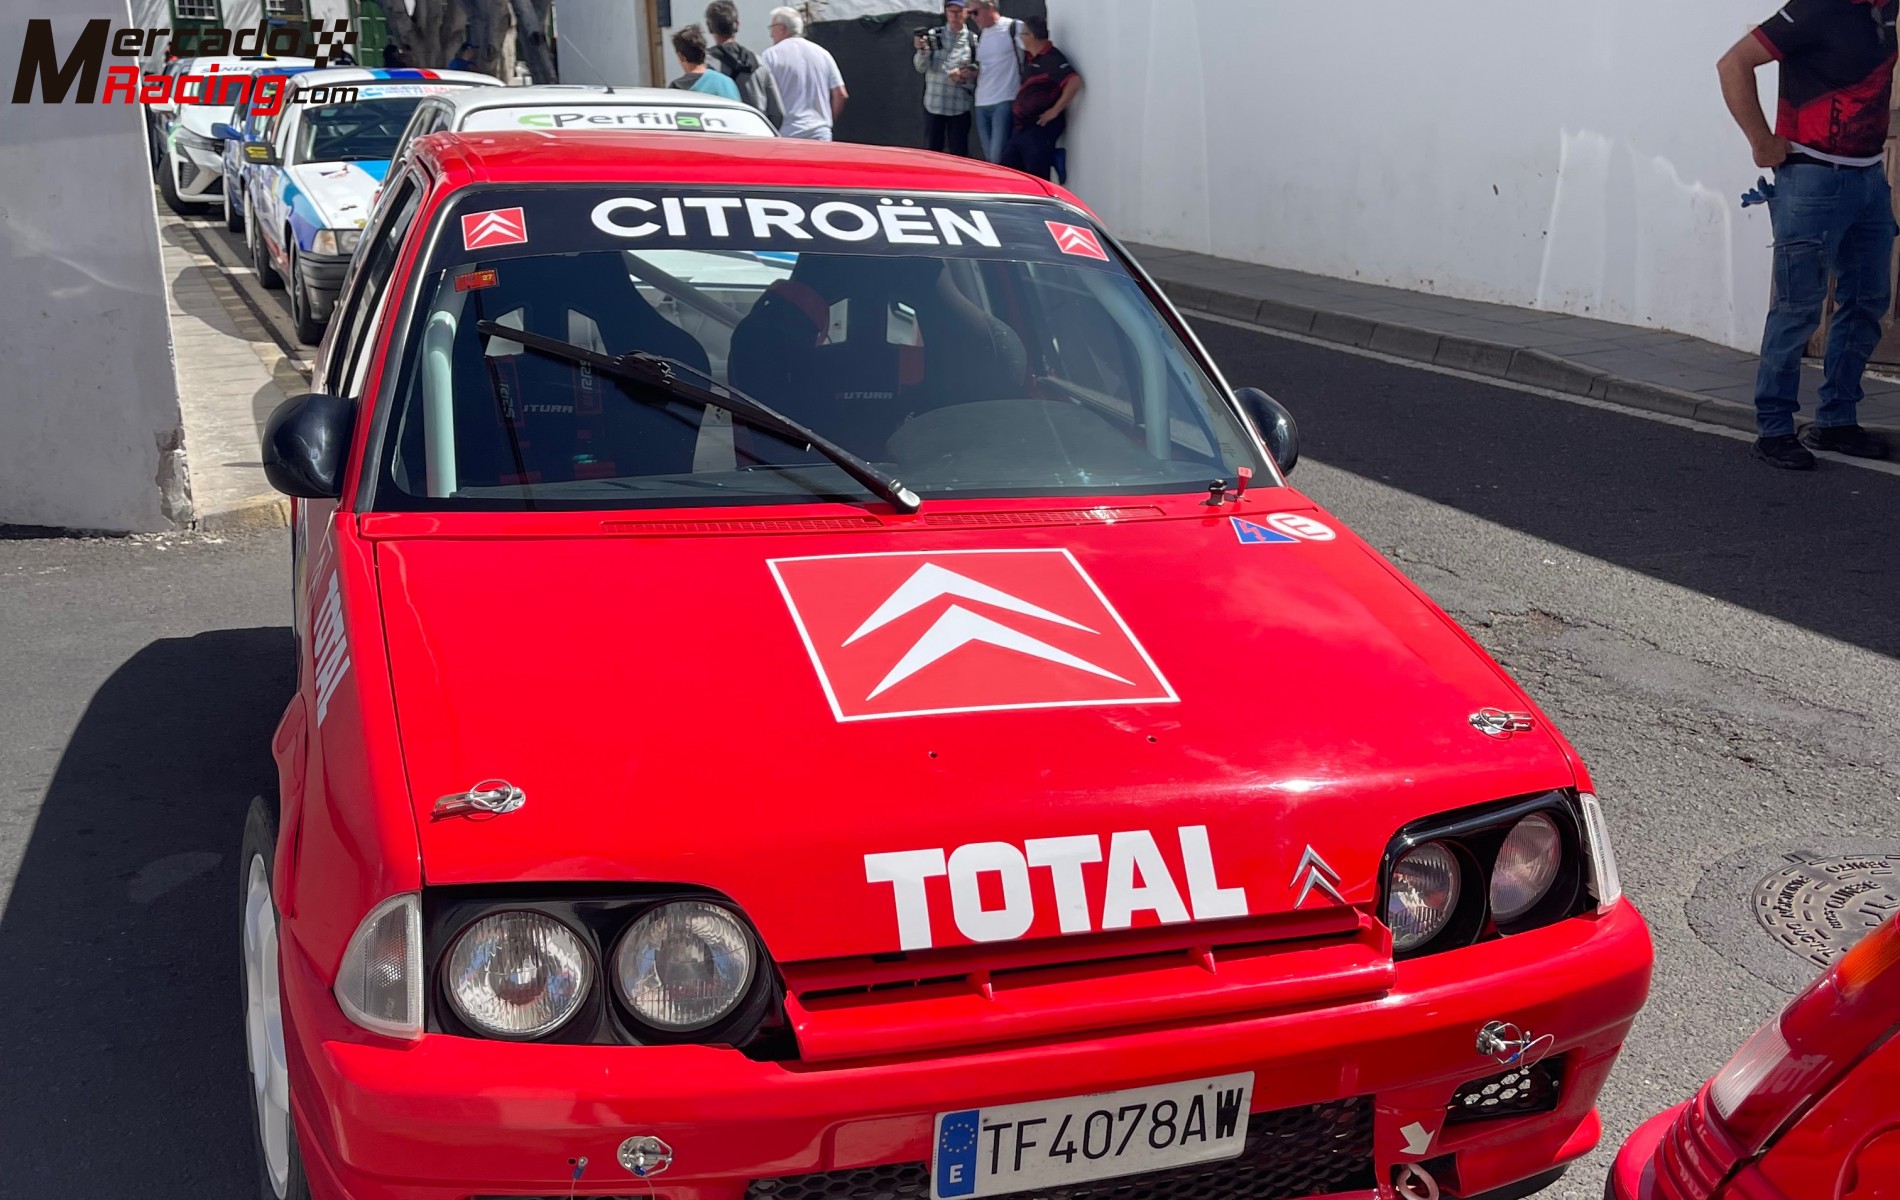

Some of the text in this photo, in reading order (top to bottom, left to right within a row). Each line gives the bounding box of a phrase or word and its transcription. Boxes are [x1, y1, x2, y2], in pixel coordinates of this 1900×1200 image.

[590, 196, 1000, 248] CITROËN
[313, 568, 351, 729] TOTAL
[864, 825, 1249, 951] TOTAL
[949, 1164, 963, 1184] E
